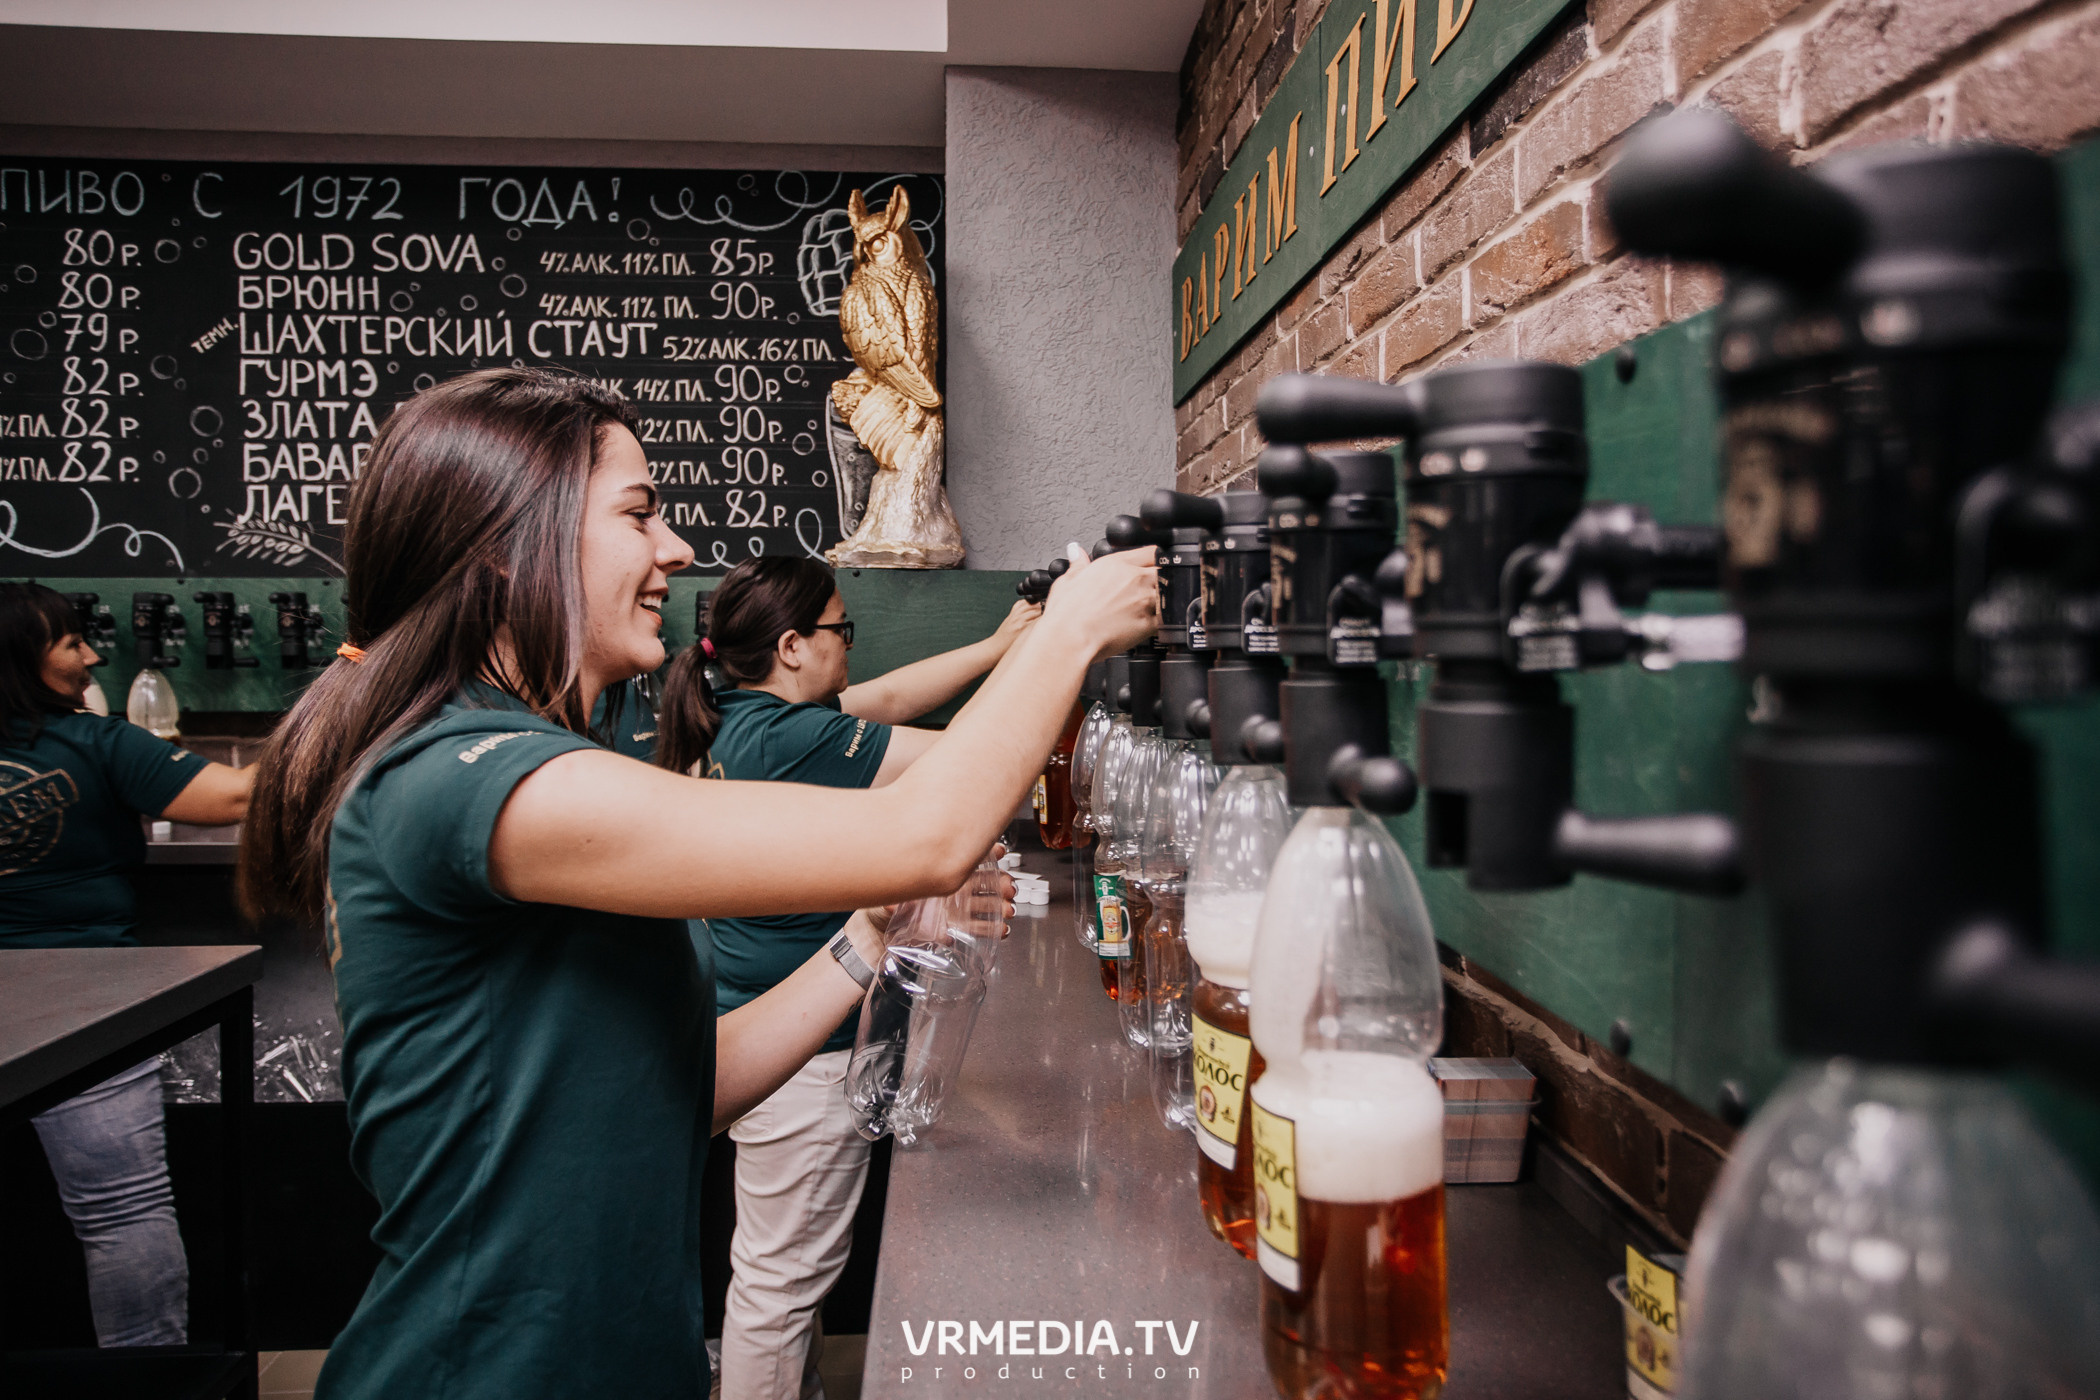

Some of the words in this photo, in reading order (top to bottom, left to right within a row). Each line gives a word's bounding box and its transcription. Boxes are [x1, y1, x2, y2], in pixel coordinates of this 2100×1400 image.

[0, 169, 145, 216] ПИВО
[193, 172, 224, 218] С
[279, 175, 404, 221] 1972
[233, 232, 355, 271] GOLD
[371, 233, 485, 273] SOVA
[1180, 110, 1302, 363] ВАРИМ
[238, 275, 379, 311] БРЮНН
[238, 309, 513, 358] ШАХТЕРСКИЙ
[528, 319, 658, 359] СТАУТ
[238, 358, 379, 397] ГУРМЭ
[242, 399, 379, 439] ЗЛАТА
[243, 442, 374, 483] БАВАР
[237, 484, 349, 524] ЛАГЕ
